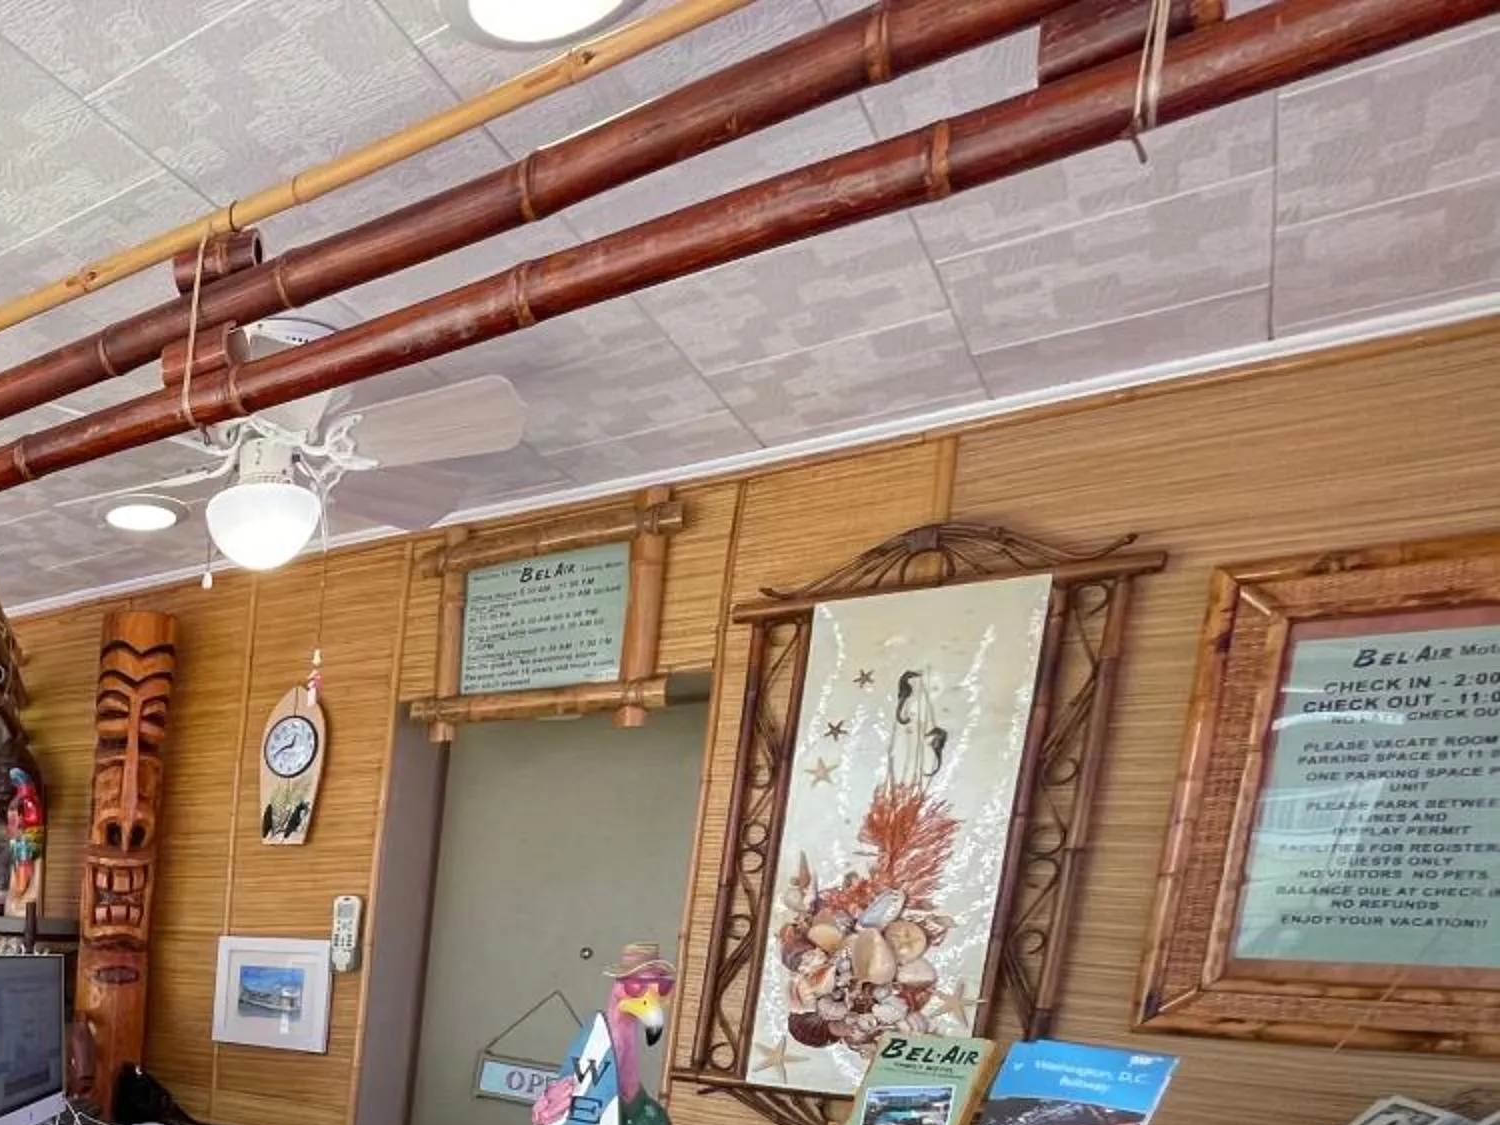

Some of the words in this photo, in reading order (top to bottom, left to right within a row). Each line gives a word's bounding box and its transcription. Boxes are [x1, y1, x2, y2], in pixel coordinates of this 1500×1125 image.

[520, 567, 551, 583] BEL
[555, 562, 575, 577] AIR
[1353, 649, 1409, 668] BEL
[1415, 645, 1453, 662] AIR
[1460, 643, 1500, 656] Mot
[1323, 677, 1403, 695] CHECK
[1409, 676, 1431, 689] IN
[1453, 672, 1500, 687] 2:00
[1303, 697, 1380, 713] CHECK
[1387, 693, 1436, 709] OUT
[1406, 709, 1471, 721] CHECK
[1474, 707, 1500, 718] OU
[1303, 740, 1368, 752] PLEASE
[1372, 737, 1437, 749] VACATE
[1297, 754, 1371, 765] PARKING
[1376, 751, 1432, 762] SPACE
[1306, 772, 1340, 781] ONE
[1344, 769, 1419, 780] PARKING
[1426, 767, 1484, 778] SPACE
[1389, 782, 1429, 792] UNIT
[1306, 801, 1369, 811] PLEASE
[1374, 800, 1418, 809] PARK
[1412, 813, 1448, 822] AND
[1406, 825, 1472, 835] PERMIT
[1370, 843, 1403, 853] FOR
[1335, 857, 1401, 866] GUESTS
[1408, 857, 1453, 866] ONLY
[1299, 870, 1322, 879] NO
[1327, 870, 1402, 879] VISITORS
[1412, 870, 1438, 879] NO
[1443, 870, 1489, 880] PETS
[1276, 886, 1353, 896] BALANCE
[1358, 887, 1393, 896] DUE
[1396, 887, 1416, 896] AT
[1422, 887, 1485, 897] CHECK
[1331, 900, 1355, 909] NO
[1359, 900, 1440, 910] REFUNDS
[1281, 916, 1334, 925] ENJOY
[1339, 916, 1384, 926] YOUR
